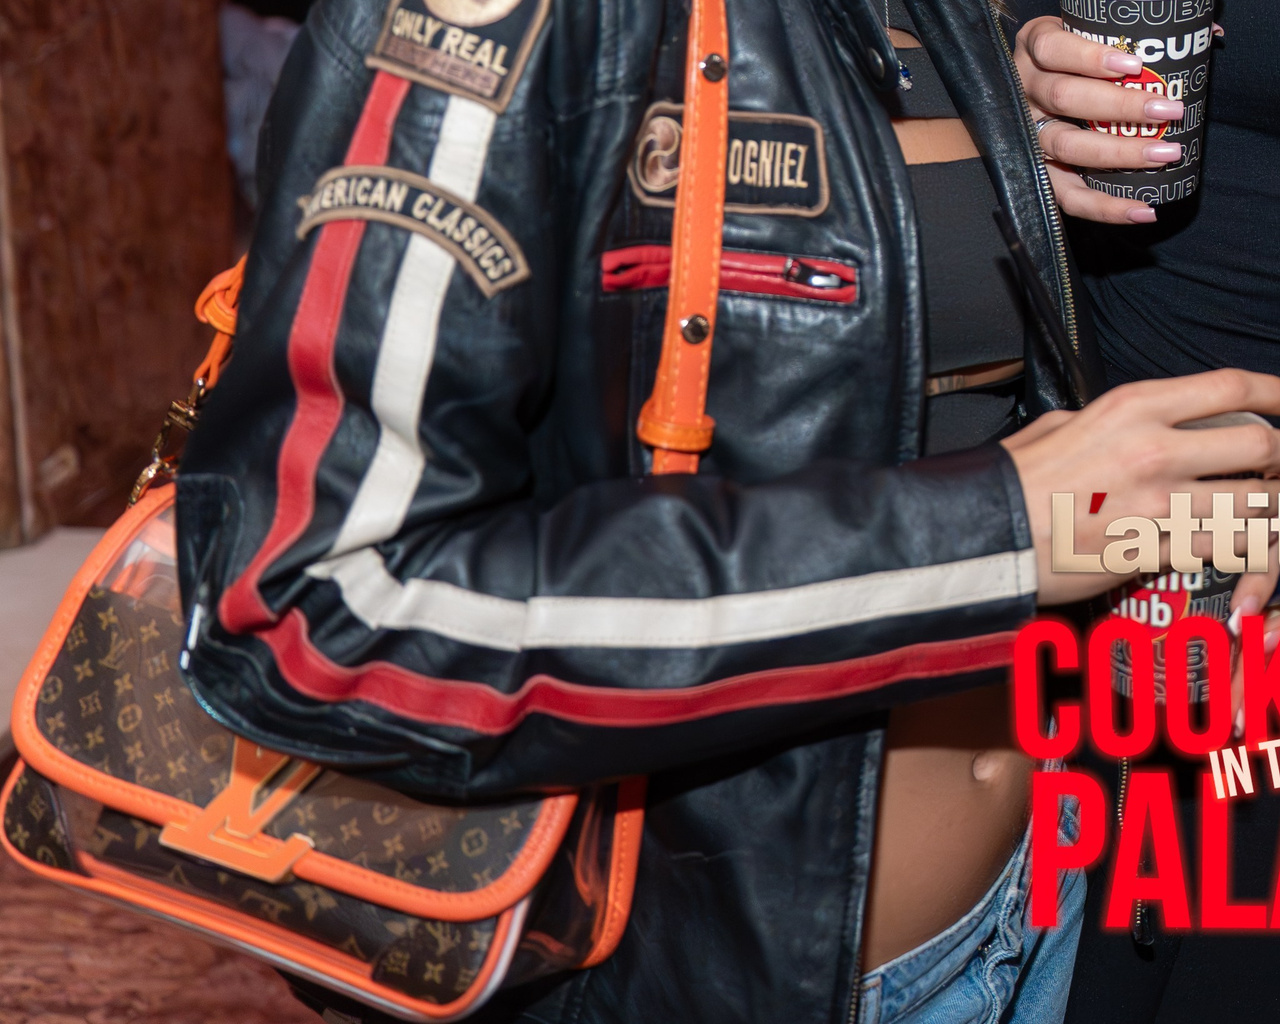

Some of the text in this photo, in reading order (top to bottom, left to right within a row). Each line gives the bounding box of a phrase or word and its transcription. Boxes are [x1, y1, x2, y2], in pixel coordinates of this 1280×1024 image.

[392, 7, 444, 48] ONLY
[438, 26, 509, 75] REAL
[1134, 27, 1213, 63] CUB
[1134, 174, 1200, 205] CUB
[412, 193, 512, 279] CLASSICS
